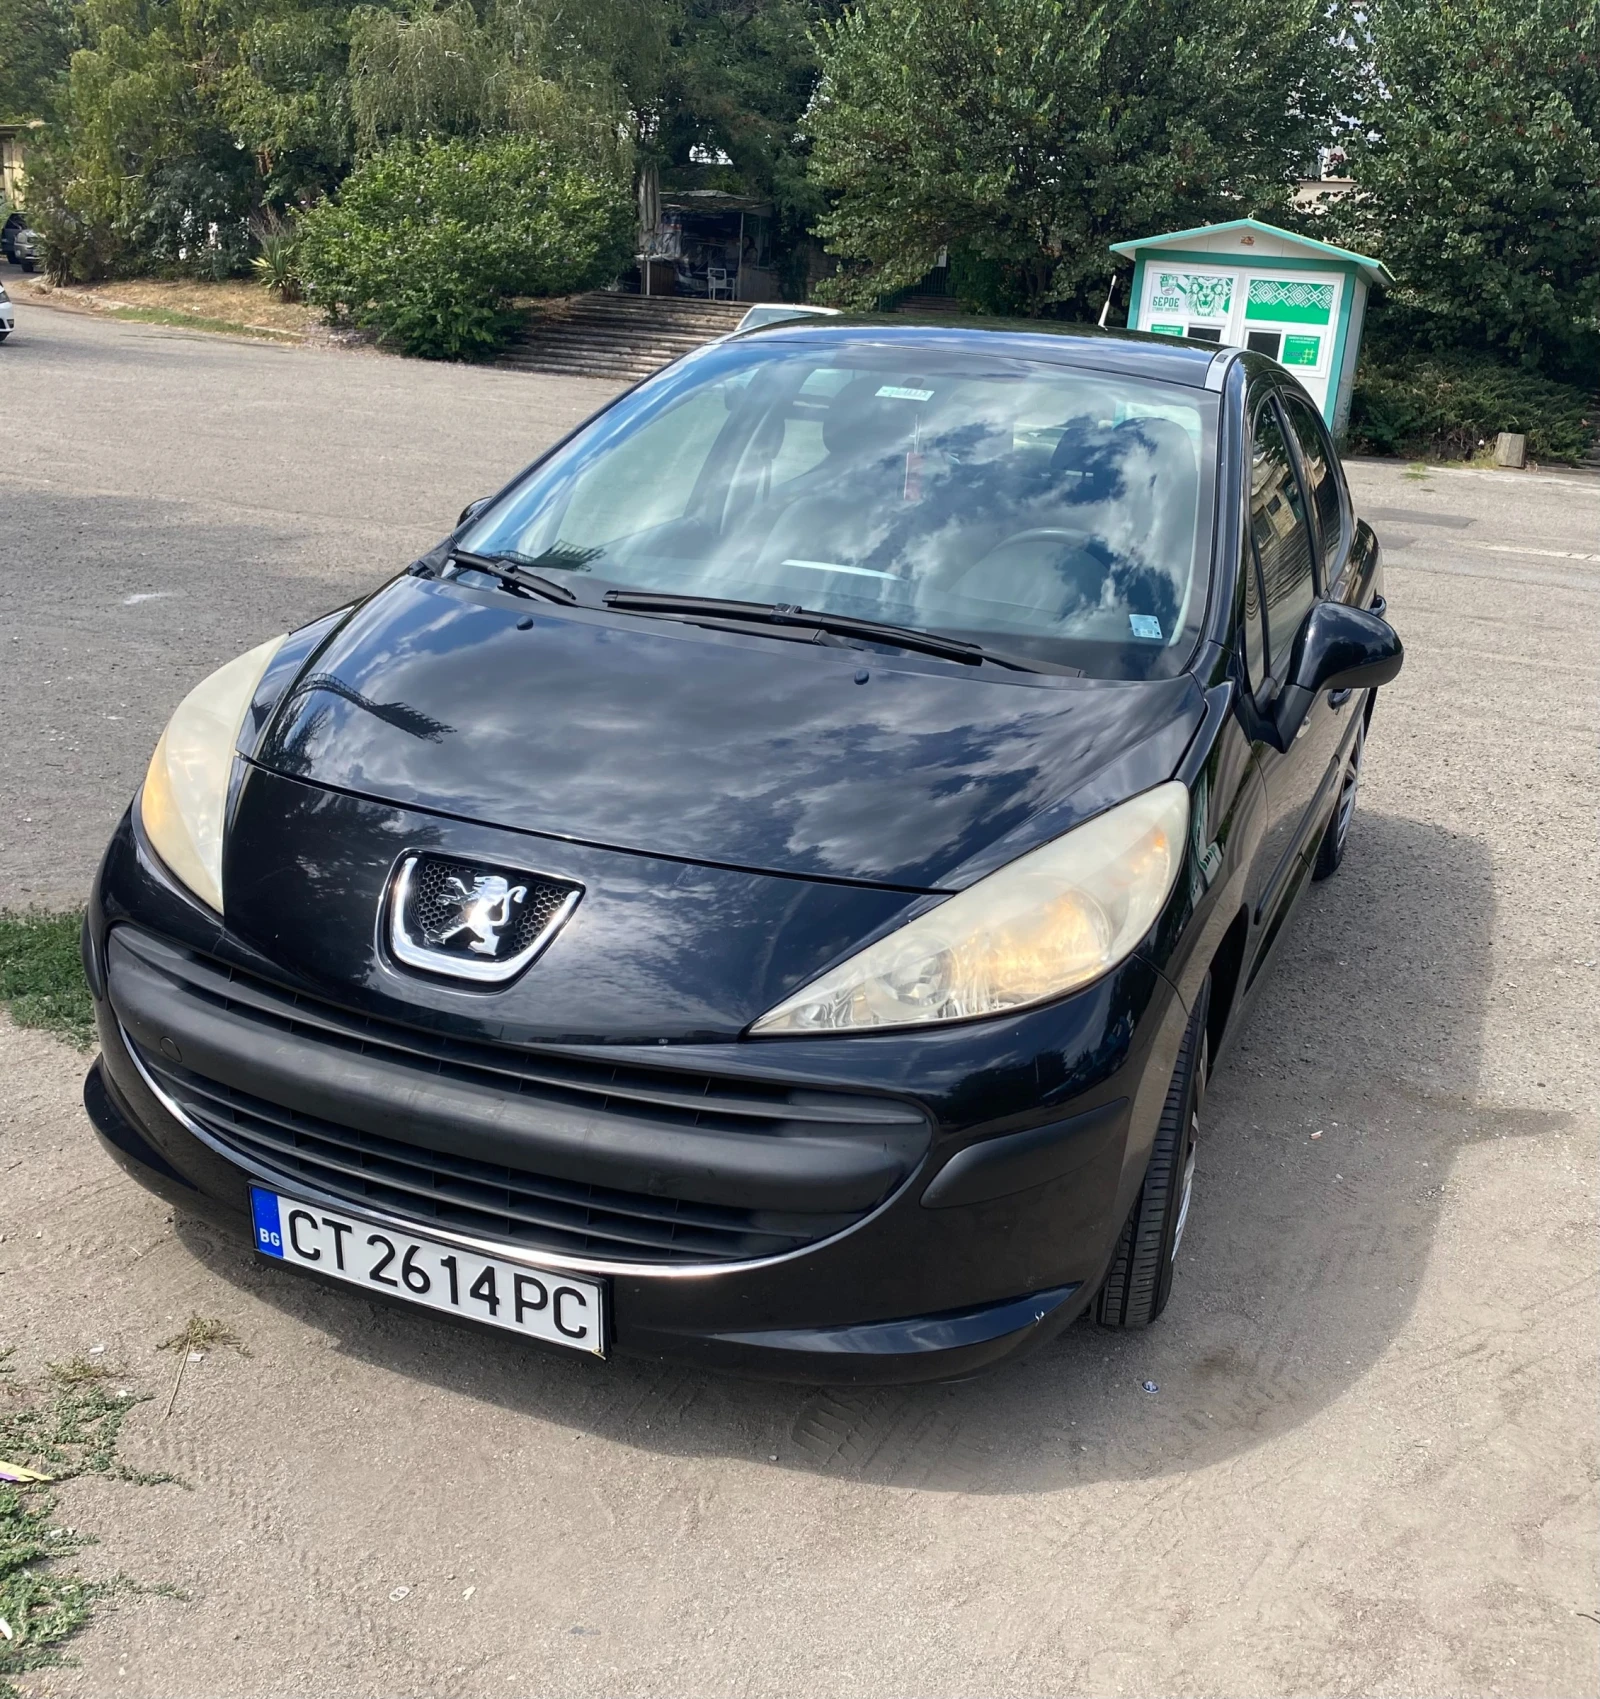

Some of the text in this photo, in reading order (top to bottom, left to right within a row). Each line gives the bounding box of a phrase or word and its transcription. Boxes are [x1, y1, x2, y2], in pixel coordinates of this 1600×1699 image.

[1152, 296, 1180, 308] БЕРОЕ
[259, 1228, 281, 1247] BG
[366, 1234, 501, 1316] 2614
